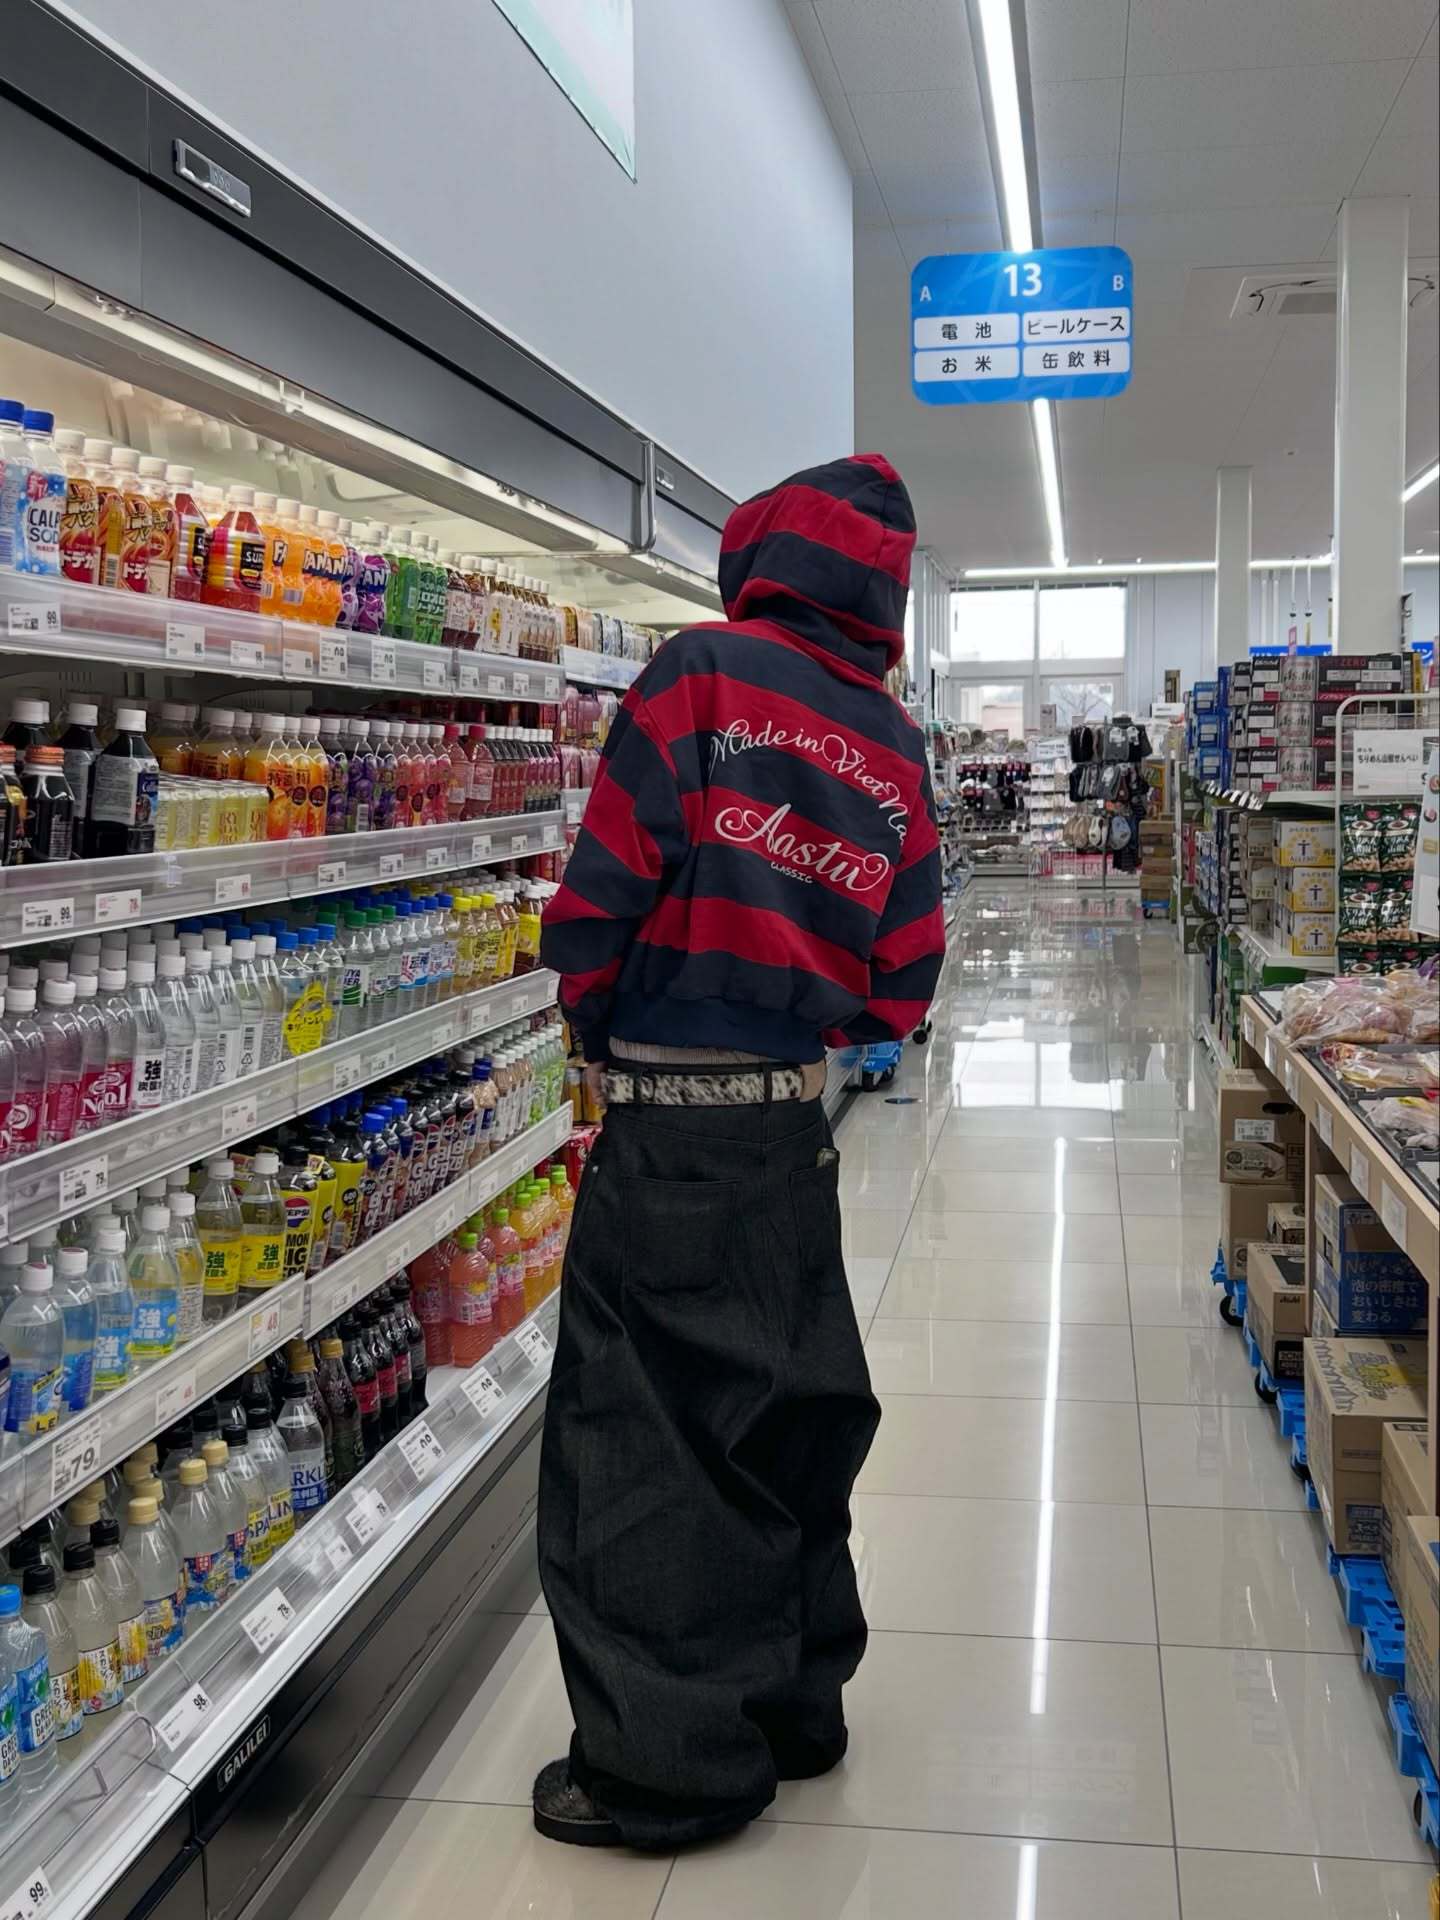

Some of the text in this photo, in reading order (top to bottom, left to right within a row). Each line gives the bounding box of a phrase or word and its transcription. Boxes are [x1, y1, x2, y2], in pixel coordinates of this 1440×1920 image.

[1003, 262, 1043, 297] 13
[1113, 275, 1125, 291] B
[920, 285, 932, 302] A
[941, 321, 992, 340] 電池
[1027, 314, 1125, 336] ビールケース
[941, 355, 992, 374] お米
[1042, 349, 1111, 369] 缶飲料
[709, 719, 787, 783] Made
[791, 728, 824, 753] in
[771, 860, 814, 884] CLASSIC
[145, 1060, 162, 1080] 強
[70, 1447, 95, 1480] 79
[29, 1882, 45, 1903] 99
